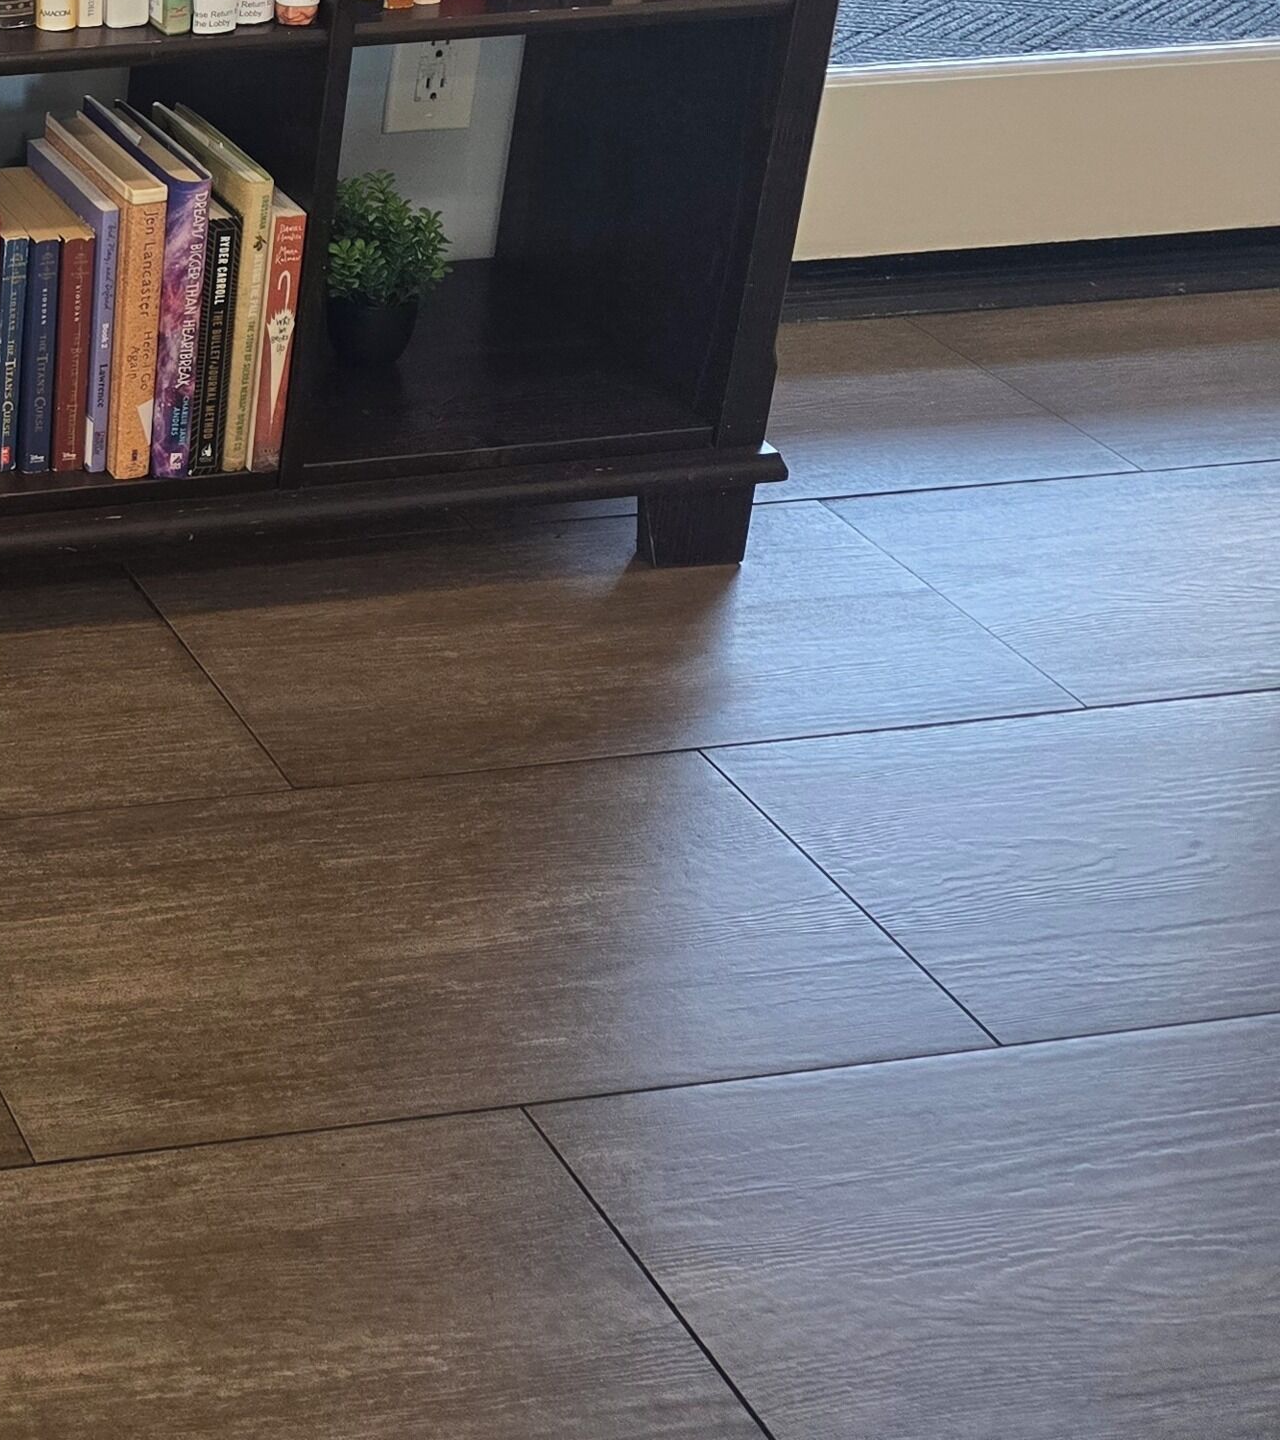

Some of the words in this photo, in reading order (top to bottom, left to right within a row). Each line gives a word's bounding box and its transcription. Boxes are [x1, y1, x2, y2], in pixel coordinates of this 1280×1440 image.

[211, 10, 234, 18] Return
[240, 10, 262, 18] Lobby
[143, 210, 158, 235] Jen
[218, 236, 231, 264] RYDER
[139, 241, 156, 317] Lancaster
[214, 267, 228, 305] CARROLL
[127, 346, 140, 380] Again
[96, 363, 108, 408] Lawrence
[171, 407, 181, 436] ANDERS
[181, 396, 190, 425] CHARLIE
[178, 426, 187, 445] JANE
